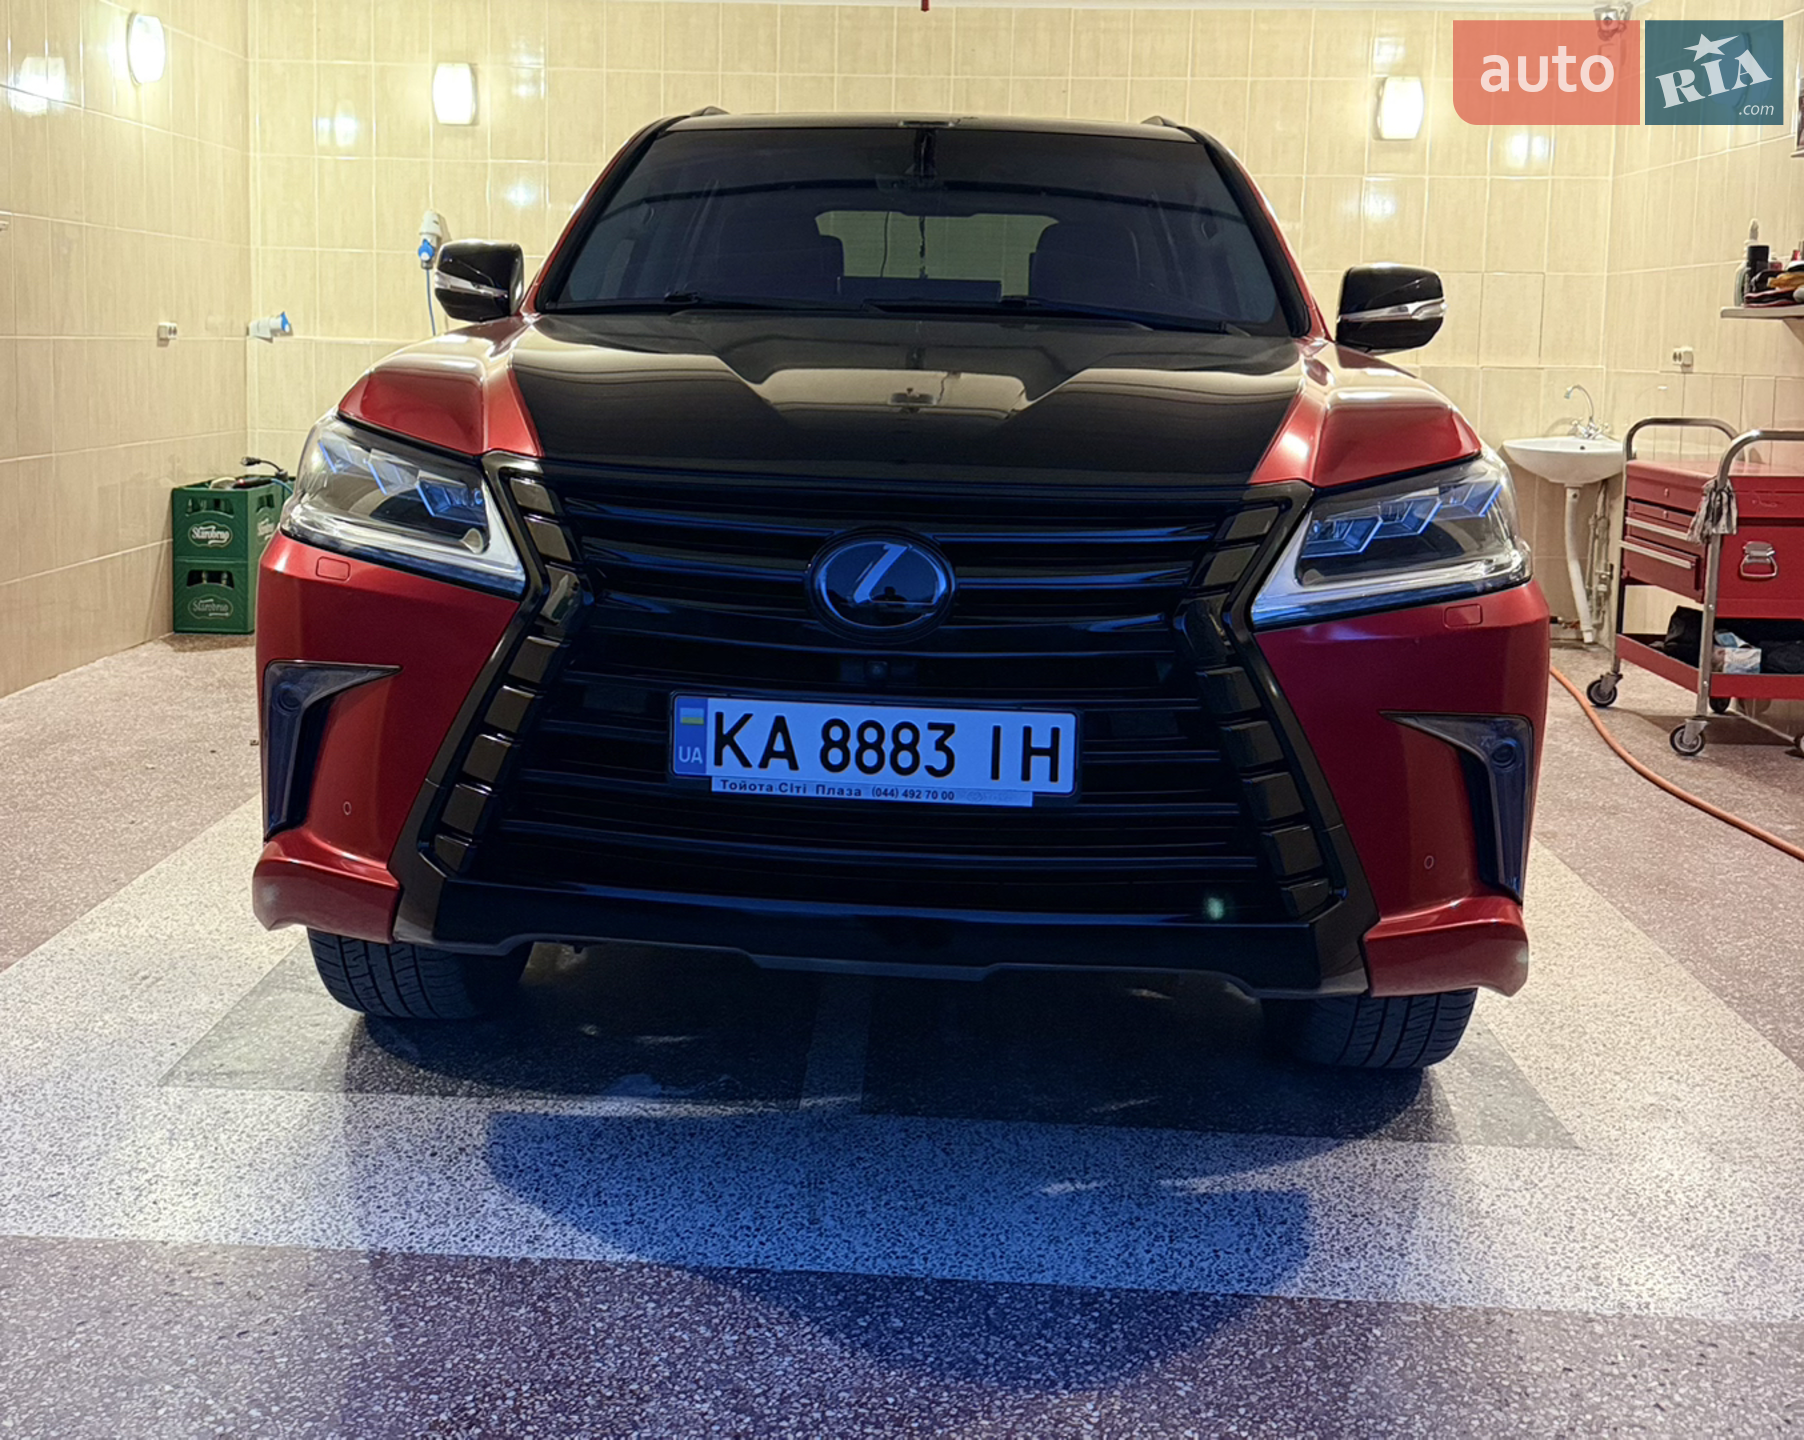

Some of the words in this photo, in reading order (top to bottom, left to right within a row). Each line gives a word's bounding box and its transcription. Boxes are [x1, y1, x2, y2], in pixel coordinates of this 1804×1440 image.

[678, 746, 703, 764] UA
[714, 711, 800, 771] KA
[819, 718, 956, 778] 8883
[990, 724, 1061, 783] IH
[720, 779, 774, 793] Тойота
[815, 784, 862, 797] Плаза
[871, 786, 899, 800] (044)
[902, 789, 922, 800] 492
[925, 790, 938, 801] 70
[940, 791, 955, 802] 00
